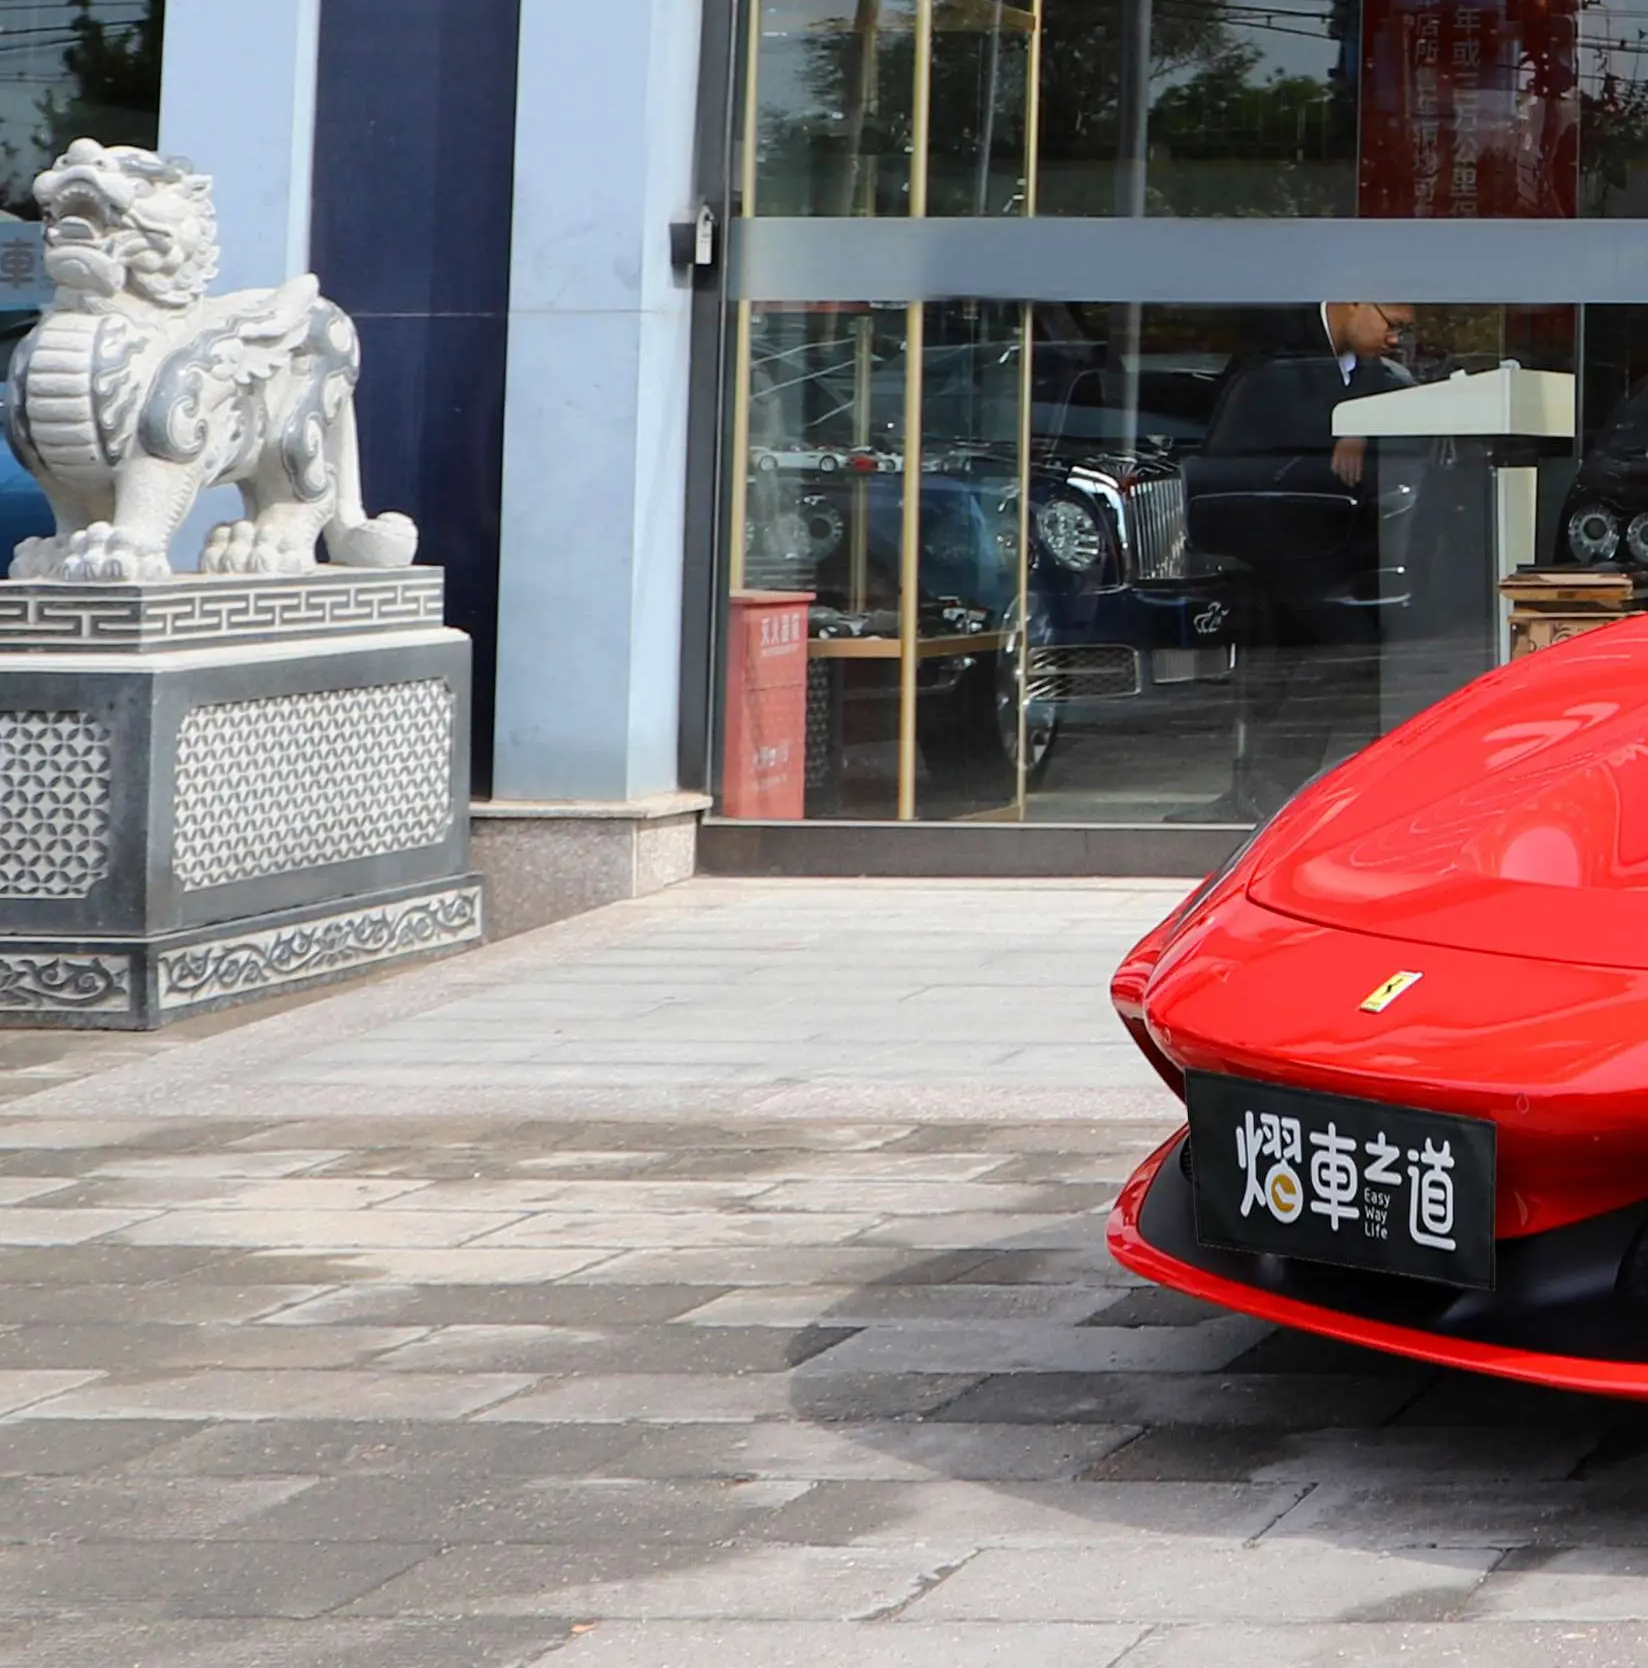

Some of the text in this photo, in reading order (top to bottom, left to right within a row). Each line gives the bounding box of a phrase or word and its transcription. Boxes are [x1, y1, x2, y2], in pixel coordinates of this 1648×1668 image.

[1364, 1187, 1391, 1210] Easy
[1364, 1205, 1388, 1225] Way
[1364, 1222, 1389, 1241] Life
